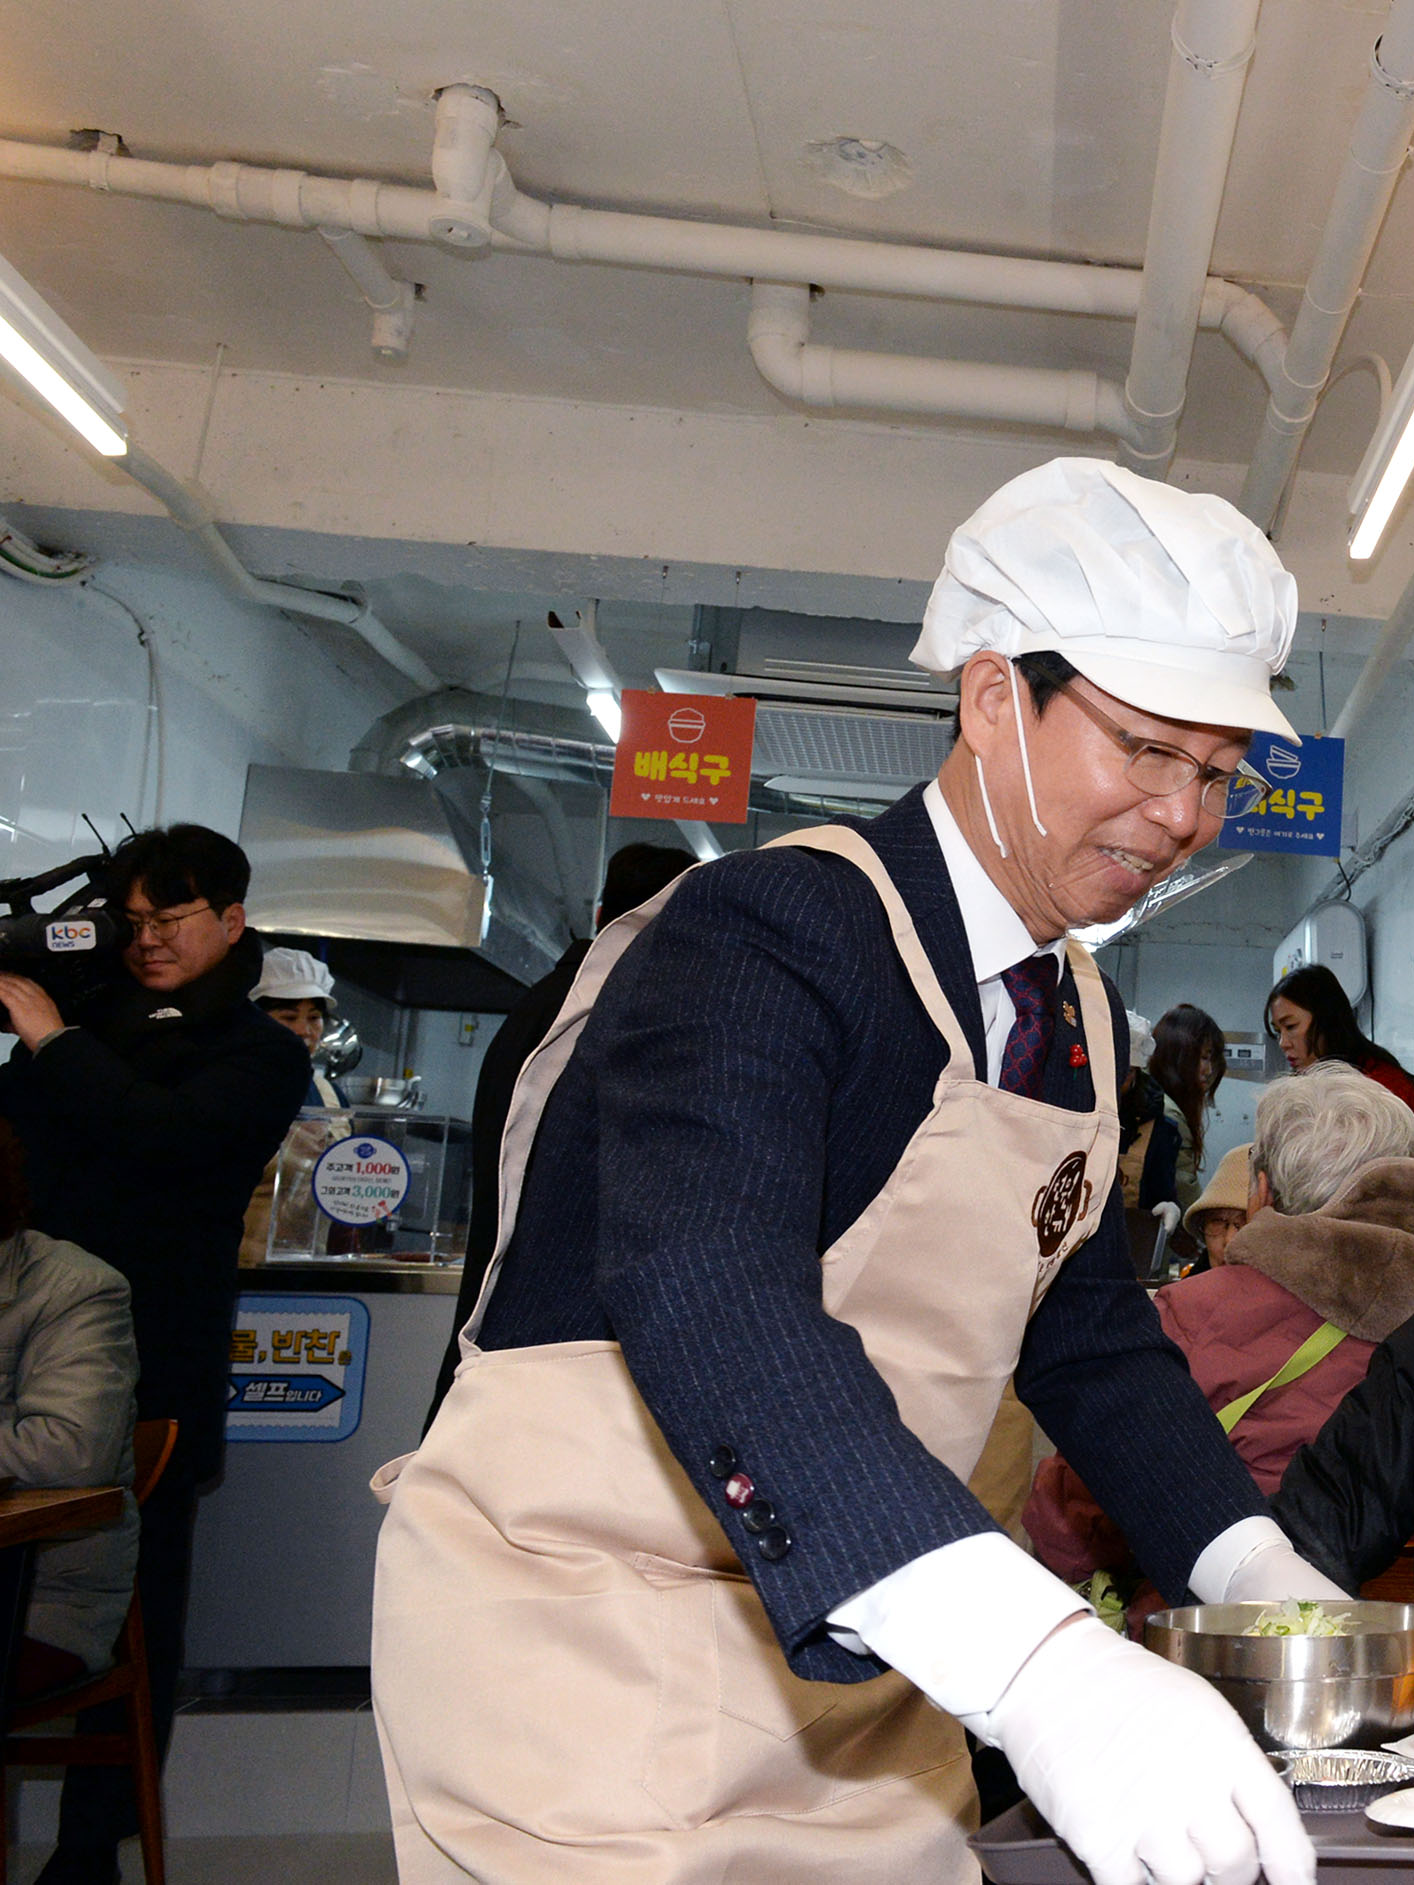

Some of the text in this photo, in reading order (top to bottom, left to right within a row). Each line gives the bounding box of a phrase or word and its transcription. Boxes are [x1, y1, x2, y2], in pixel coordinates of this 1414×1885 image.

[634, 751, 731, 785] 배식구
[1250, 788, 1325, 821] 식구
[51, 925, 91, 940] kbc
[243, 1381, 322, 1402] 셀프입니다
